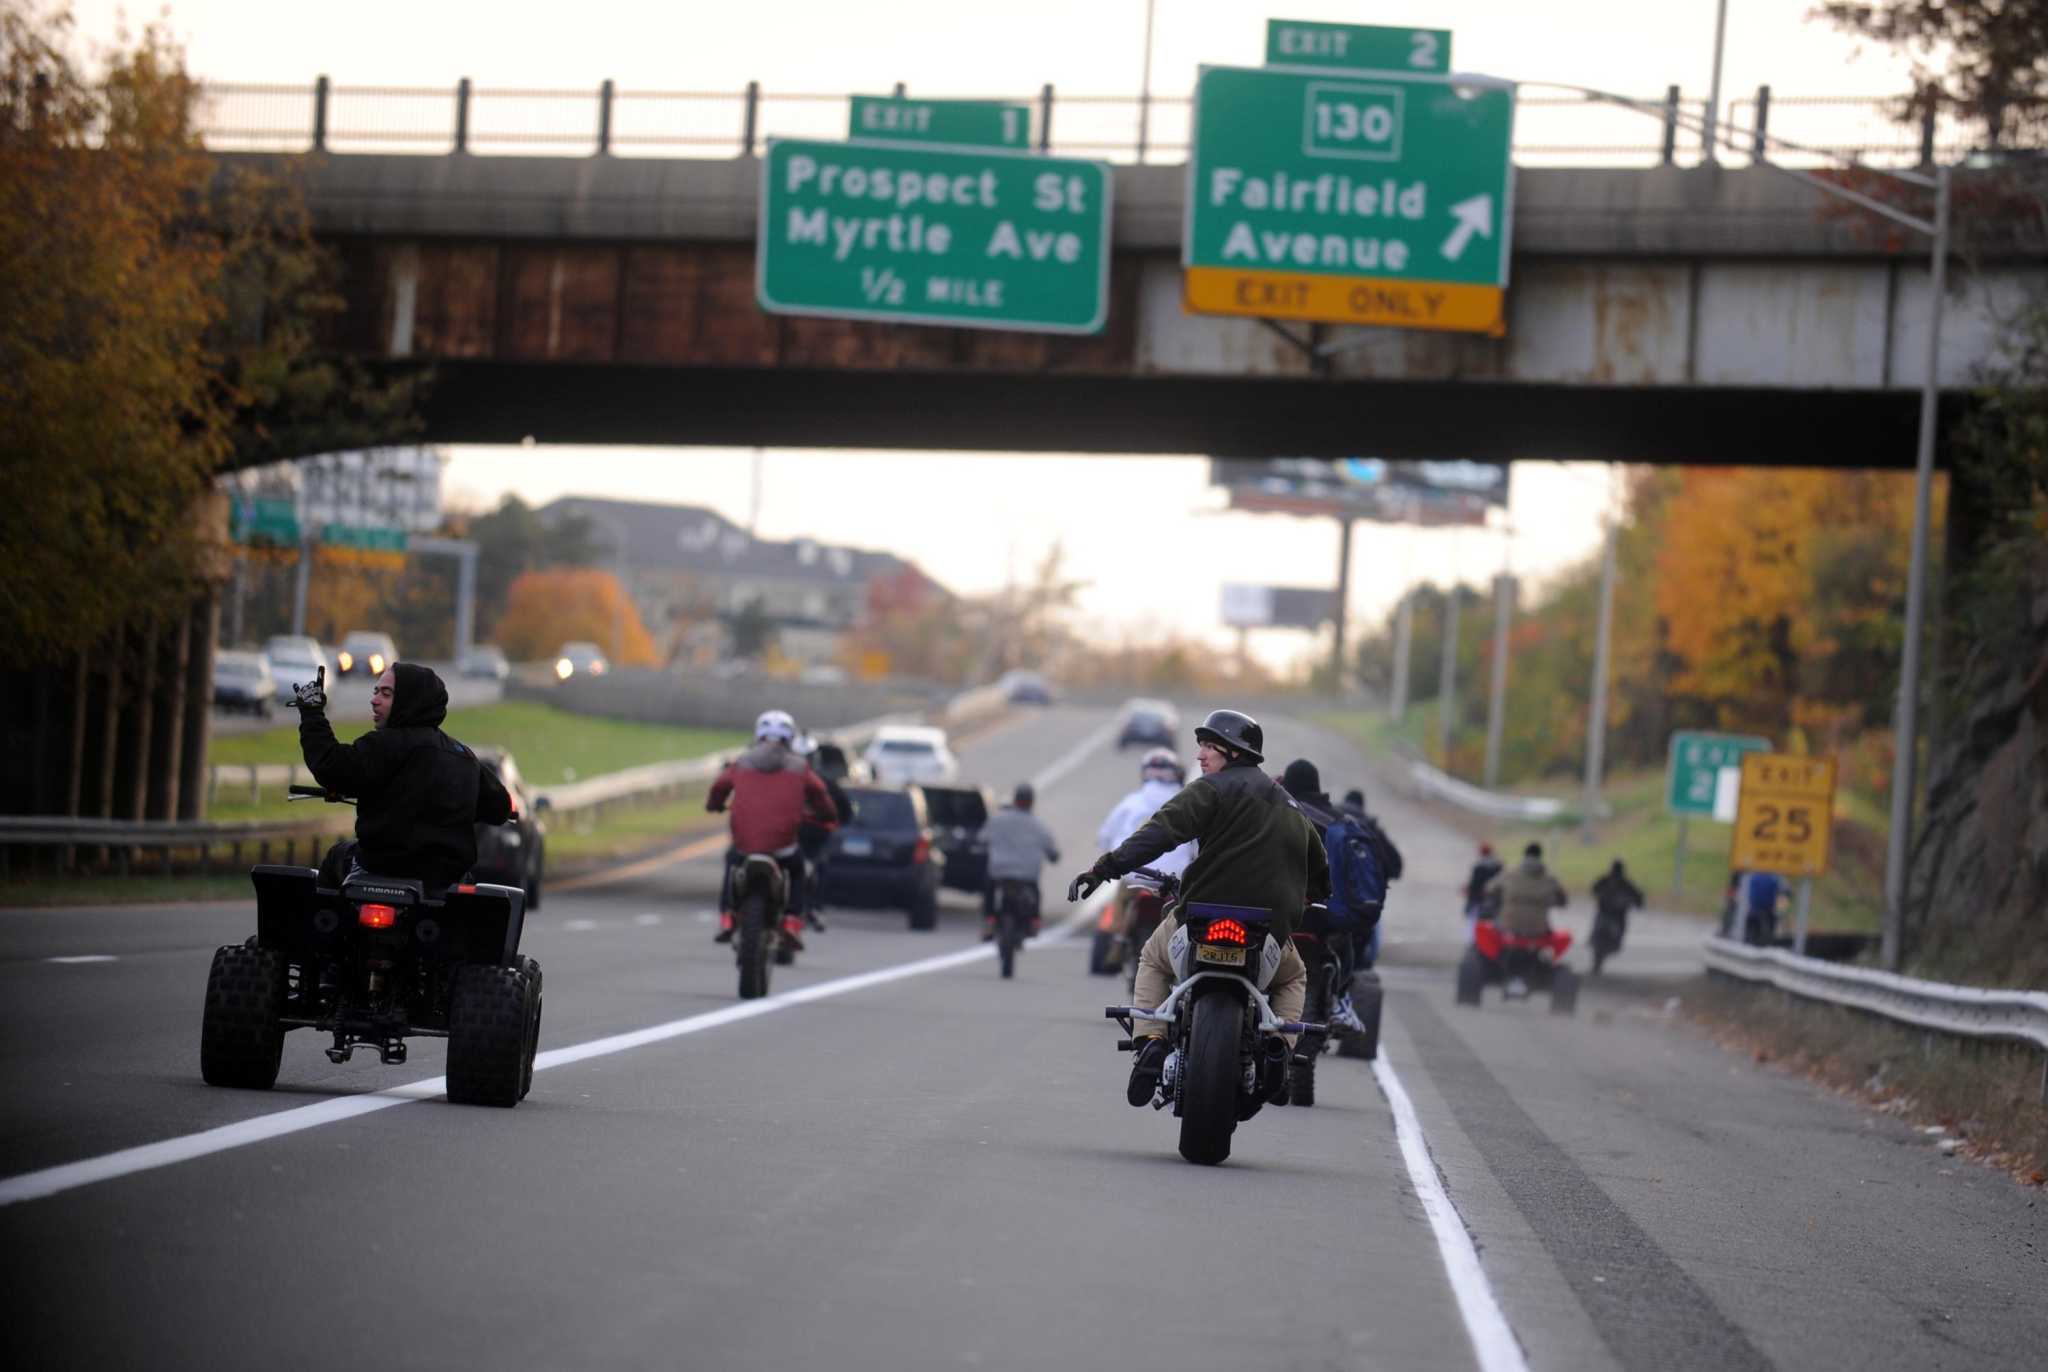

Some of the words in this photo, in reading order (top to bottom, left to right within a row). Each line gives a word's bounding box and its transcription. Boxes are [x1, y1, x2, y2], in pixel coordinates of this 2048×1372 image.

[1278, 28, 1350, 58] EXIT
[1409, 33, 1438, 67] 2
[861, 104, 932, 132] EXIT
[1001, 109, 1018, 144] 1
[1315, 105, 1393, 142] 130
[787, 156, 998, 207] Prospect
[1035, 173, 1085, 213] St
[1211, 168, 1426, 219] Fairfield
[787, 207, 951, 261] Myrtle
[986, 221, 1081, 263] Ave
[1222, 222, 1410, 270] Avenue
[927, 276, 1004, 307] MILE
[1236, 278, 1310, 306] EXIT
[1350, 287, 1445, 315] ONLY
[1753, 804, 1812, 844] 25
